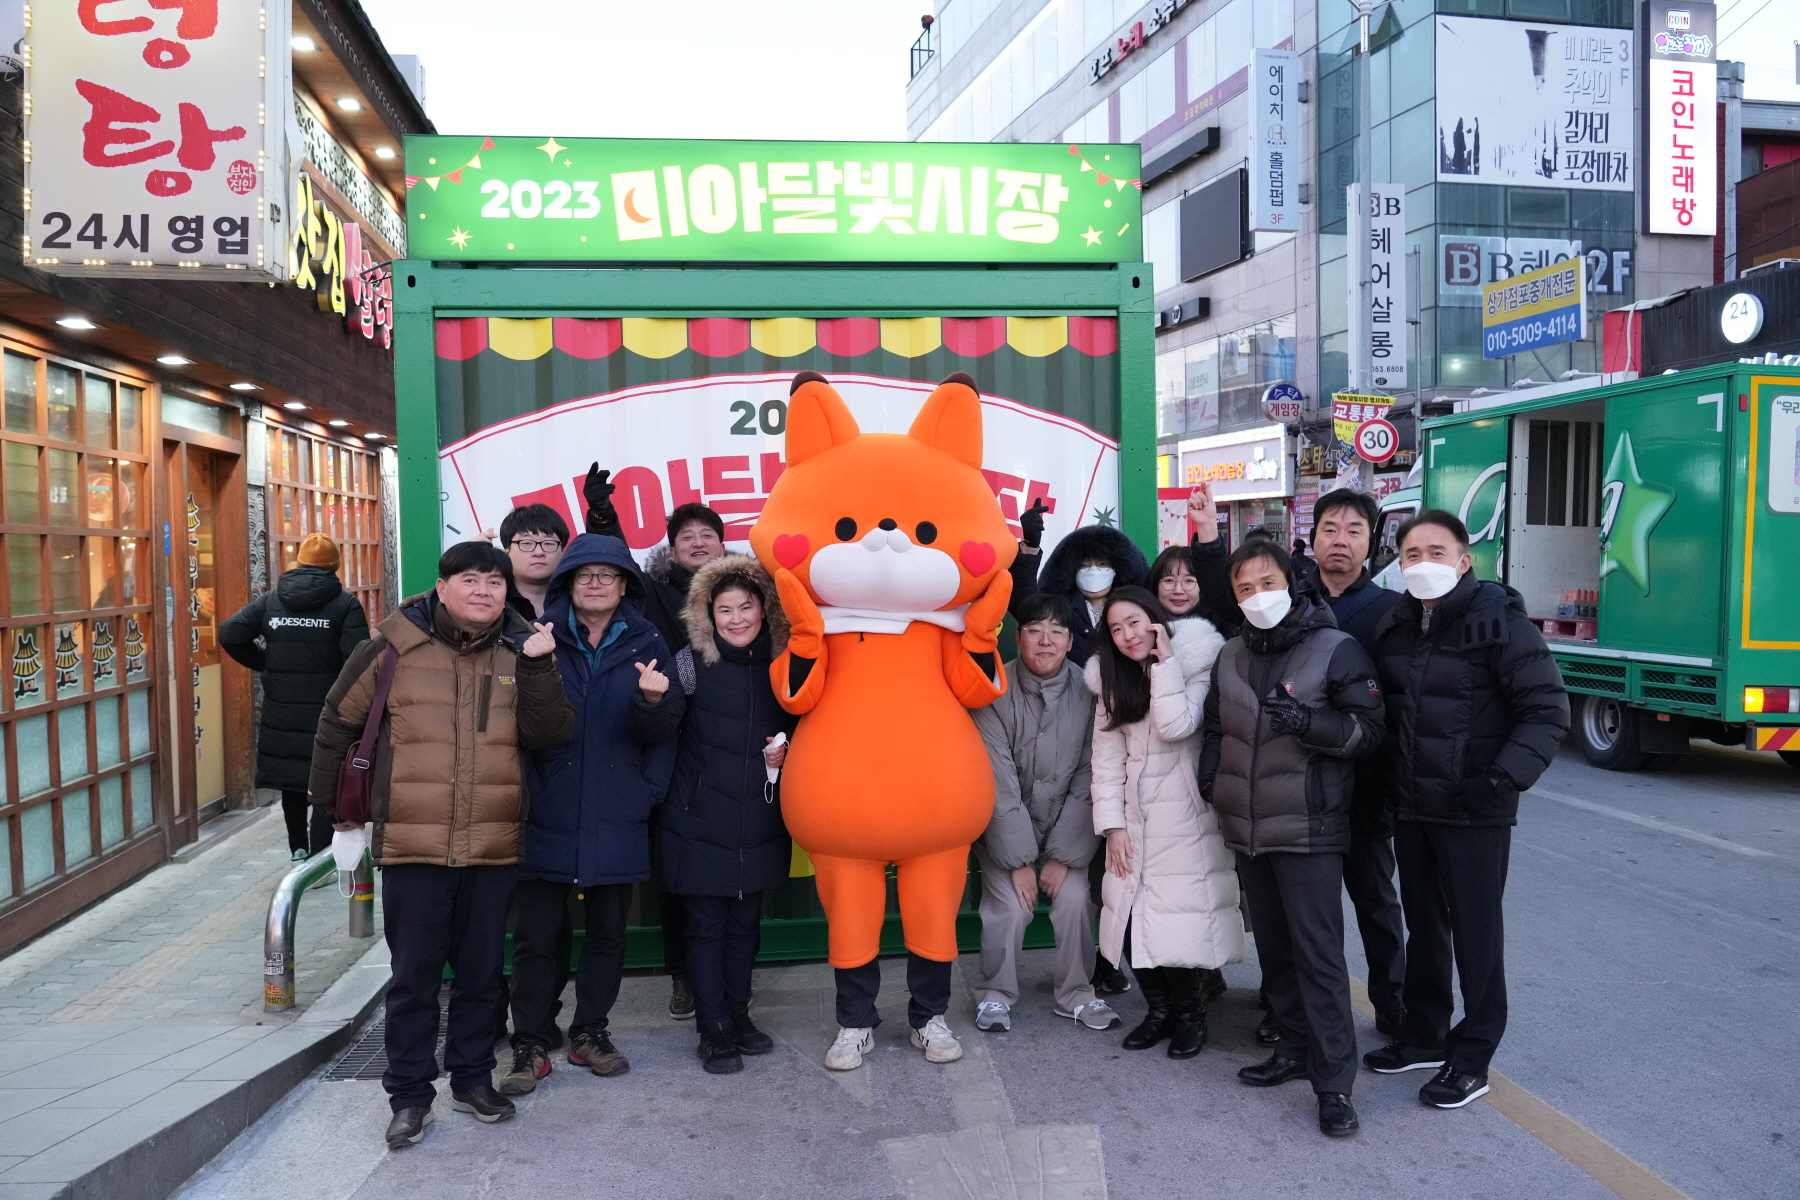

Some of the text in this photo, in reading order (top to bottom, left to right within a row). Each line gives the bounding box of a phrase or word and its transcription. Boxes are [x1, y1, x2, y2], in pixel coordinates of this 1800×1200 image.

[1668, 15, 1689, 25] COIN
[1117, 22, 1143, 62] 노래
[1269, 66, 1284, 121] 에이치
[1564, 68, 1611, 105] 추억의
[1564, 109, 1609, 144] 길거리
[1671, 70, 1696, 226] 코인노래방
[1269, 151, 1284, 207] 홀덤펍
[1564, 149, 1629, 184] 포장마차
[480, 160, 1069, 244] 2023 미아달빛시장
[1270, 213, 1284, 224] 3F
[41, 212, 249, 255] 24시 영업
[1371, 227, 1393, 358] 헤어살롱
[1486, 268, 1577, 316] 상가점포중개전문
[1730, 299, 1749, 319] 24
[1487, 313, 1577, 352] 010-5009-4114
[1270, 403, 1300, 417] 게임장
[1273, 387, 1299, 399] 스타
[1334, 403, 1389, 422] 교통통제
[1364, 430, 1389, 449] 30
[1185, 461, 1244, 483] 코인노래연습장
[1300, 445, 1323, 472] 스타
[281, 617, 330, 629] DESCENTE
